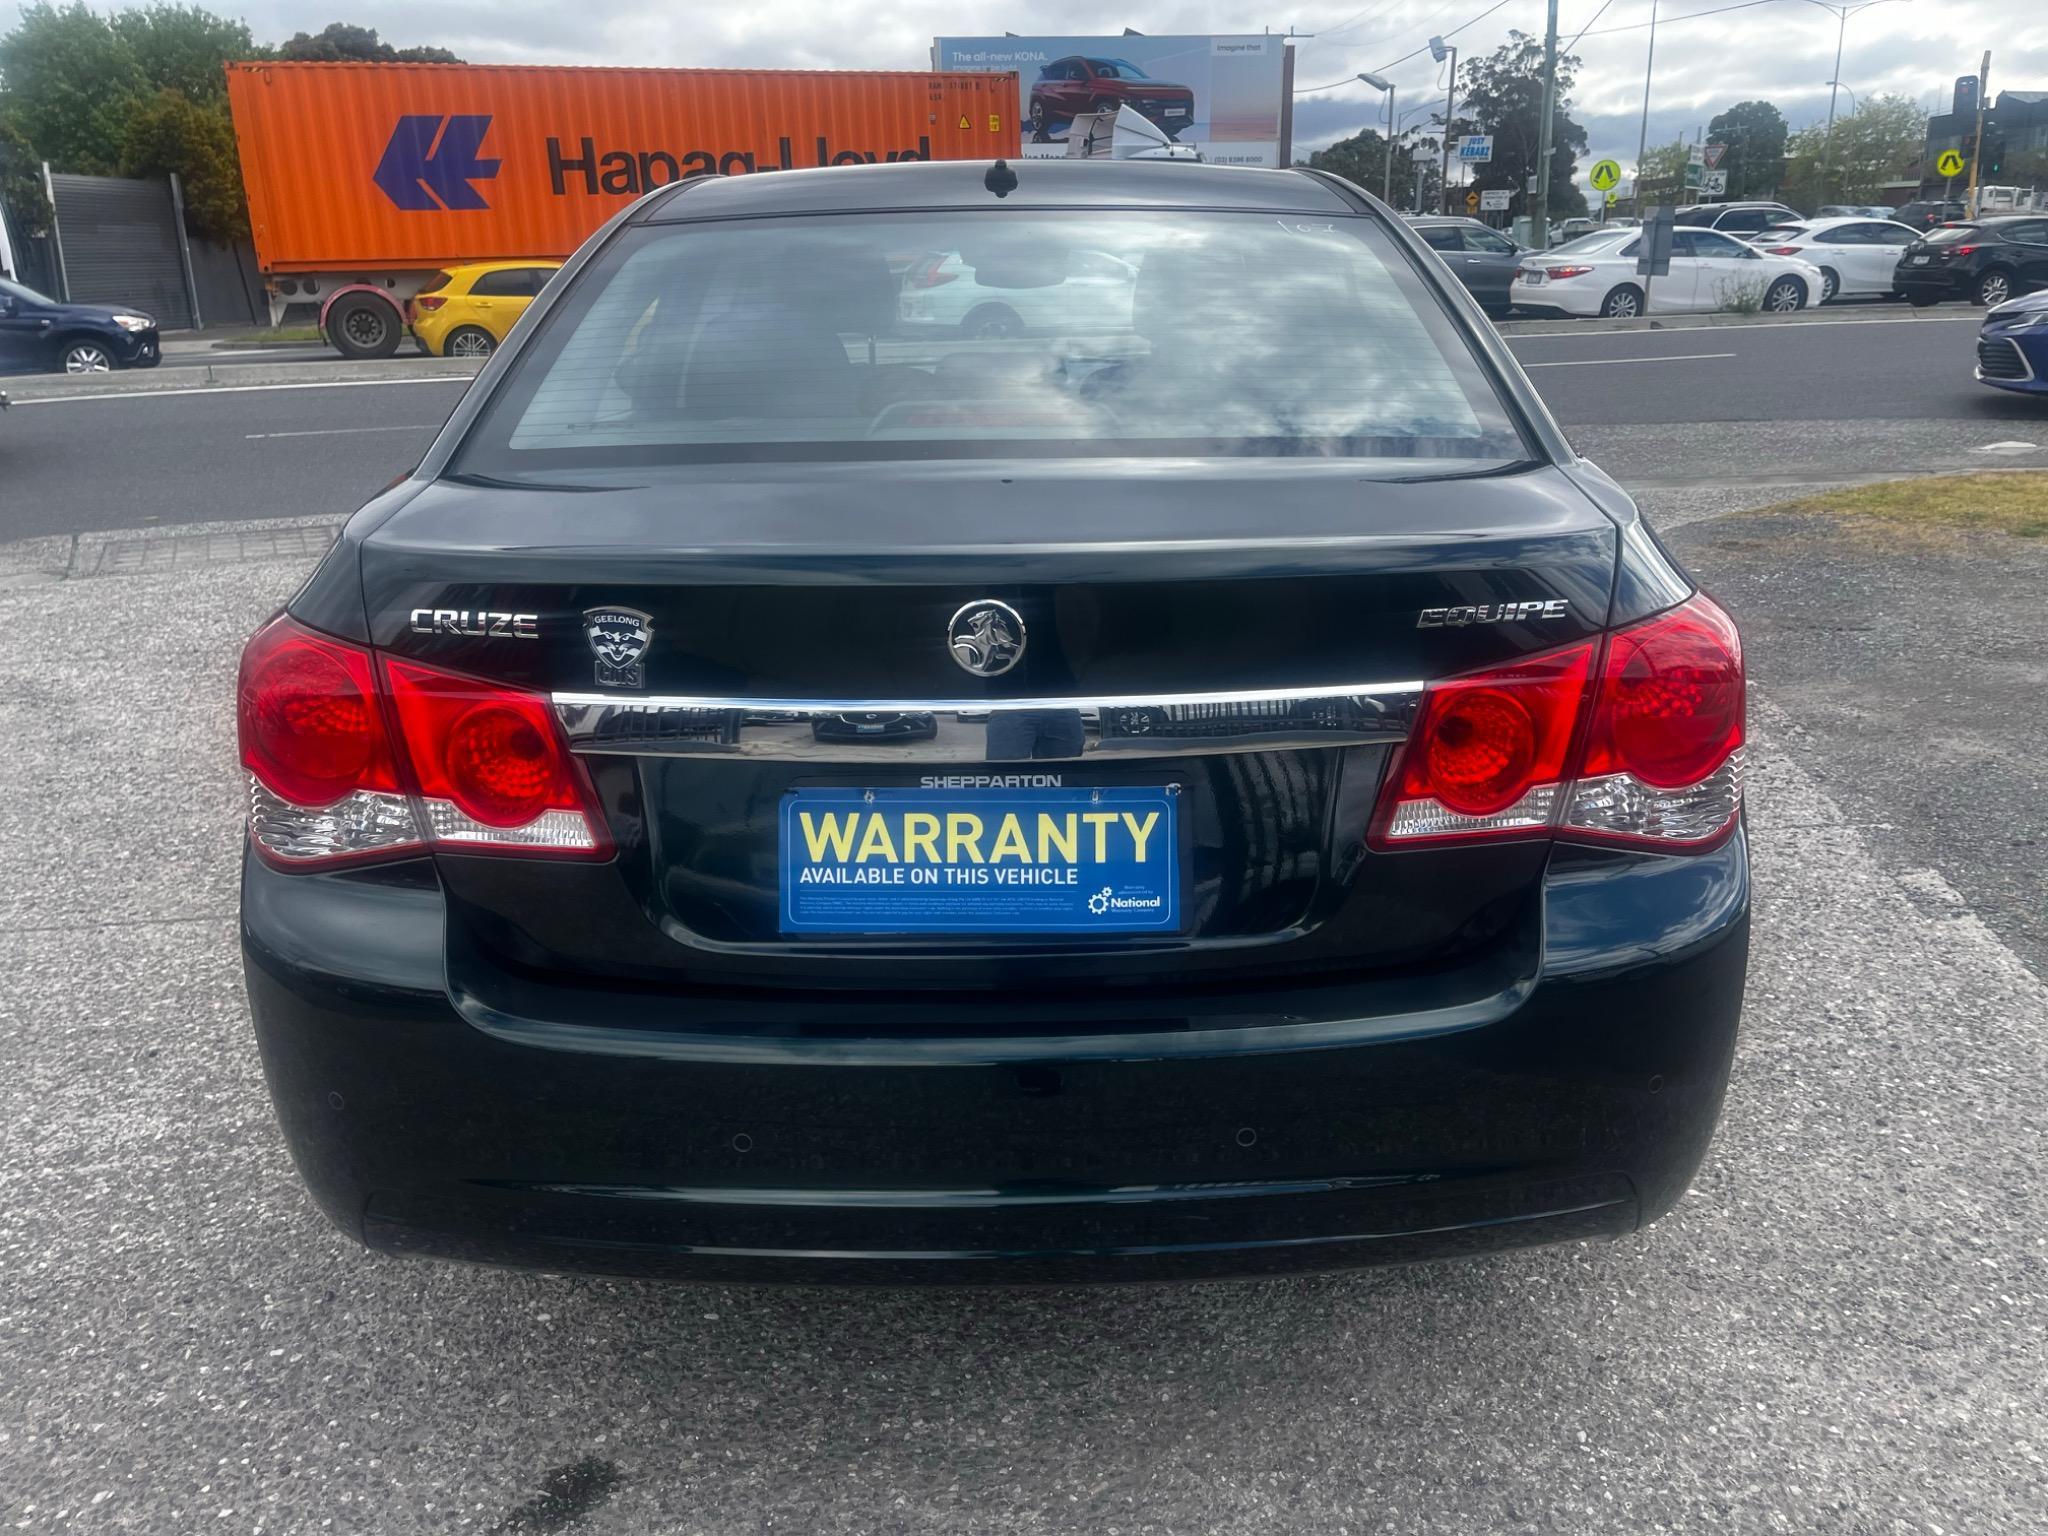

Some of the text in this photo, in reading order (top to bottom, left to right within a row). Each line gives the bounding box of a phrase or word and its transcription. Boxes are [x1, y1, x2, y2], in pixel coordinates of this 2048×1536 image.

[952, 52, 972, 61] The
[973, 51, 1012, 61] all-new
[594, 614, 640, 627] GEELONG
[1416, 599, 1569, 629] EQUIPE
[410, 608, 540, 639] CRUZE
[920, 774, 1062, 789] SHEPPARTON
[799, 812, 1160, 864] WARRANTY
[800, 868, 1078, 885] AVAILABLE ON THIS VEHICLE
[1110, 896, 1160, 908] National
